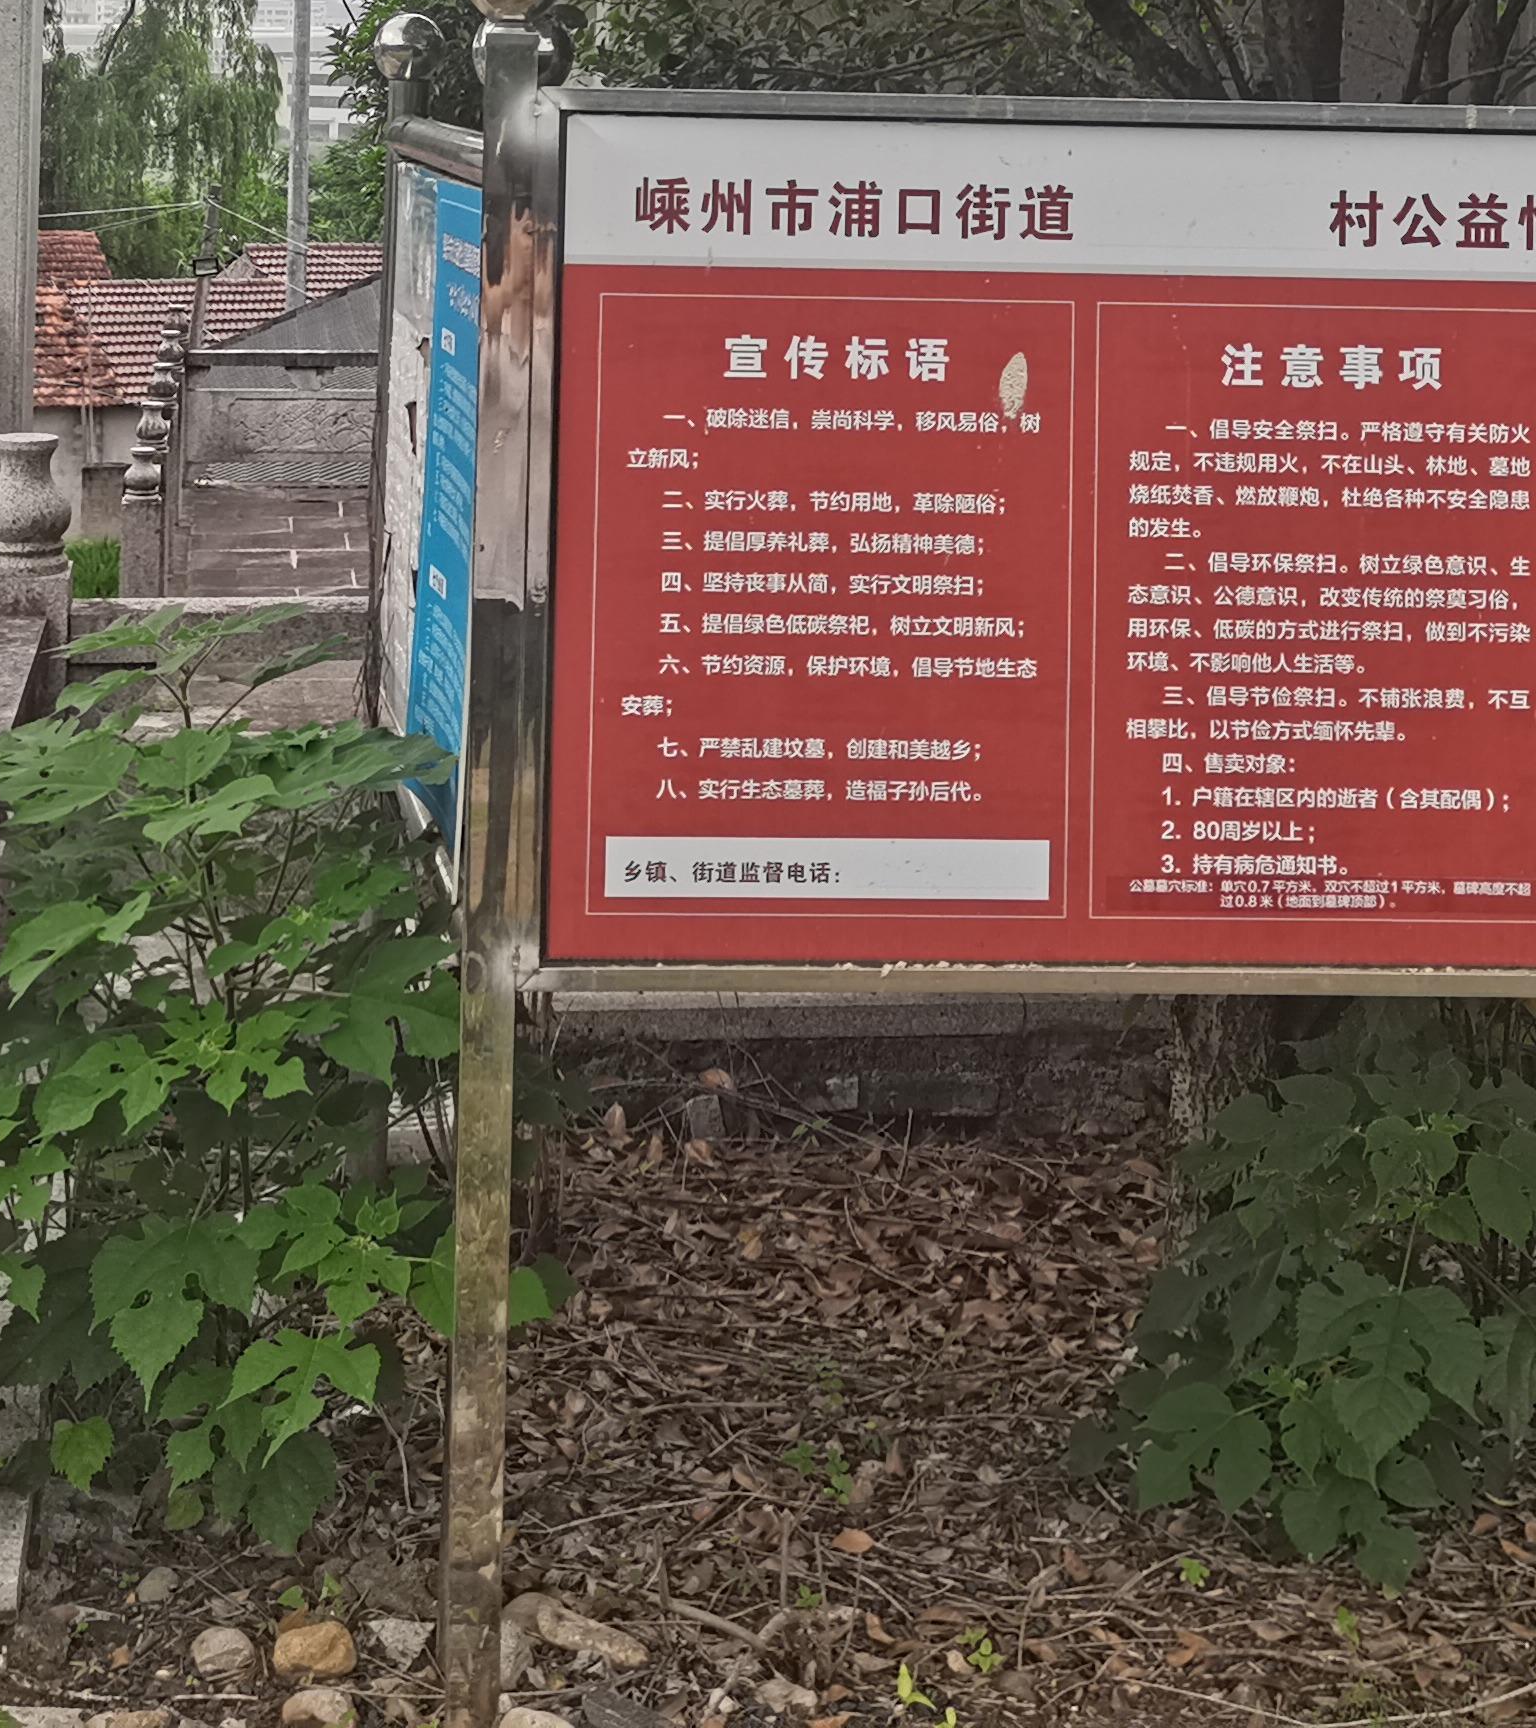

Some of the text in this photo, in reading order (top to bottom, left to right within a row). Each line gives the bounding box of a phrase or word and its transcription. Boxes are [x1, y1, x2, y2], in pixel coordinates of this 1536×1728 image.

[636, 177, 1073, 240] 嵊州市浦口街道
[723, 335, 949, 381] 宣传标语
[1221, 343, 1441, 390] 注意事项
[627, 448, 698, 469] 立新风；
[1129, 517, 1201, 538] 的发生。
[621, 695, 672, 716] 安葬；
[1163, 753, 1295, 774] 四、售卖对象：
